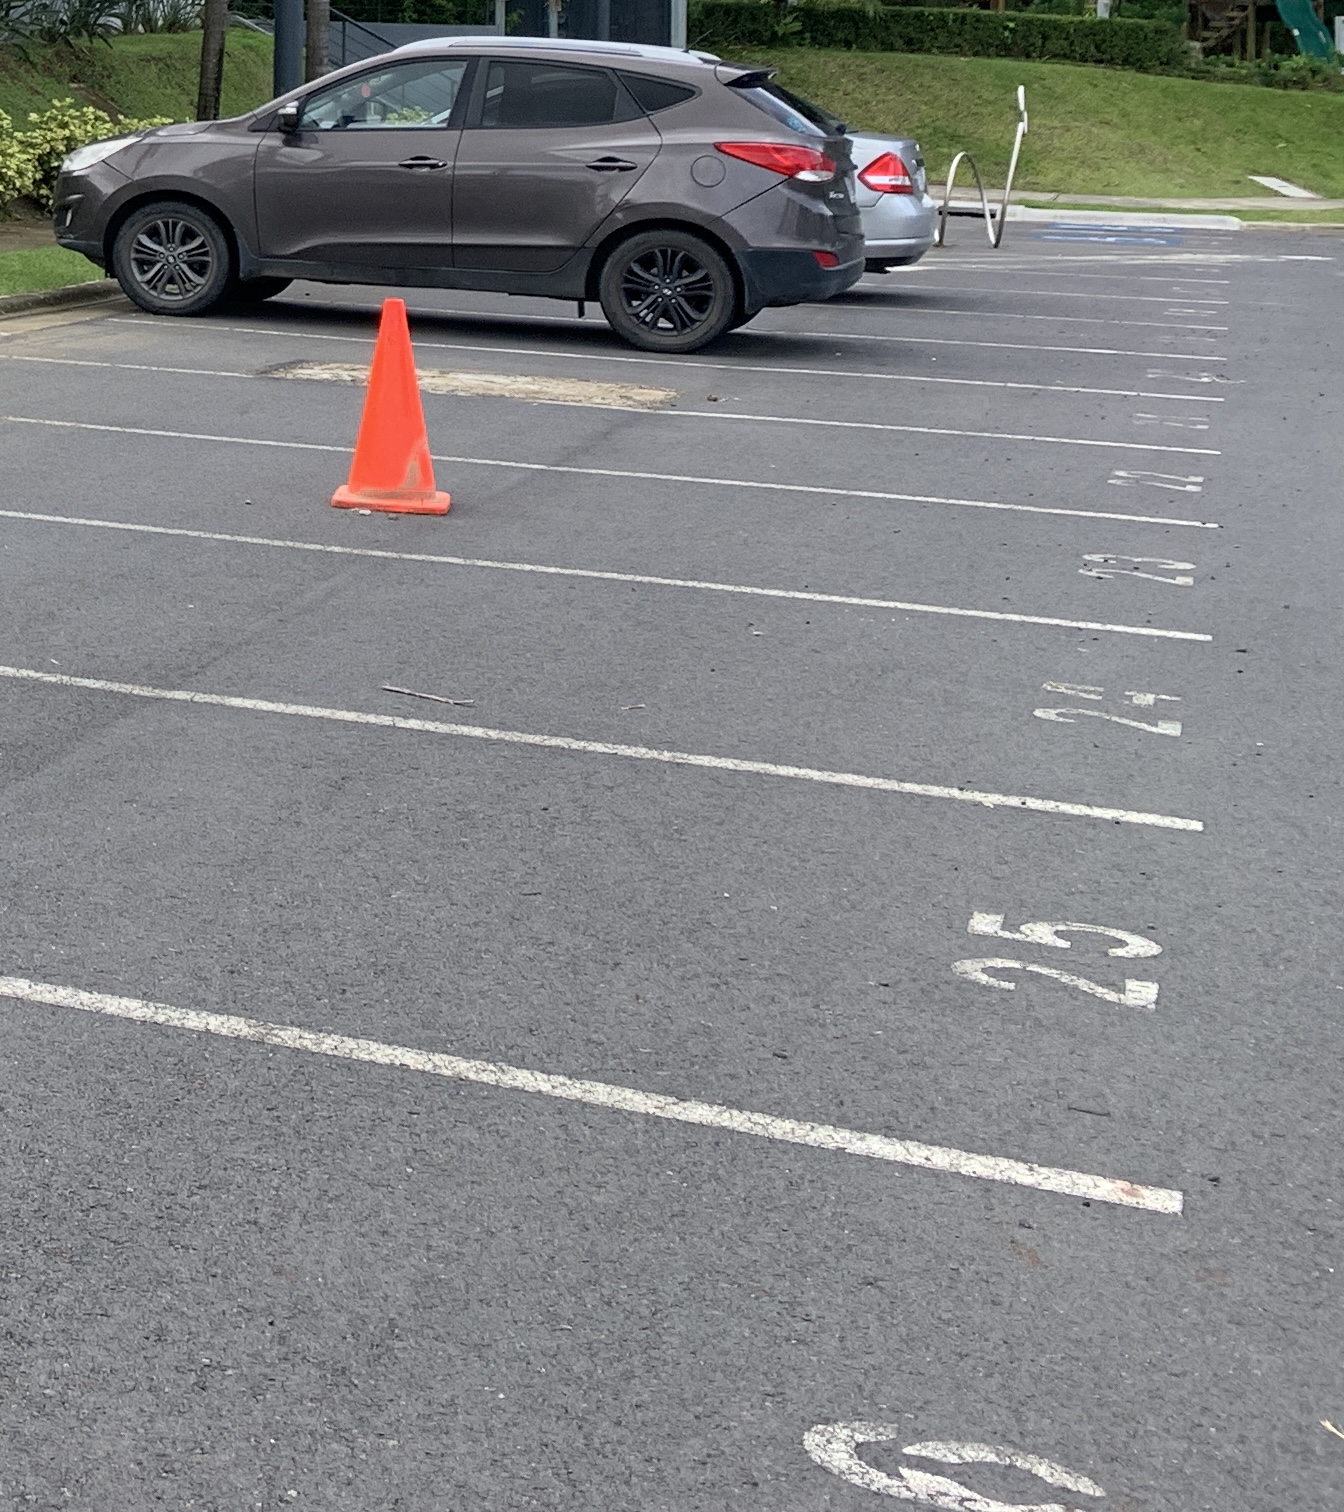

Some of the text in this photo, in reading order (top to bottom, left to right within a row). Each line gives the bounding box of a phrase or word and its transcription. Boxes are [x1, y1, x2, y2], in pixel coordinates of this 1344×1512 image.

[1107, 470, 1205, 492] 22
[1078, 553, 1197, 586] 23
[1032, 680, 1183, 737] 24
[950, 910, 1163, 1010] 25
